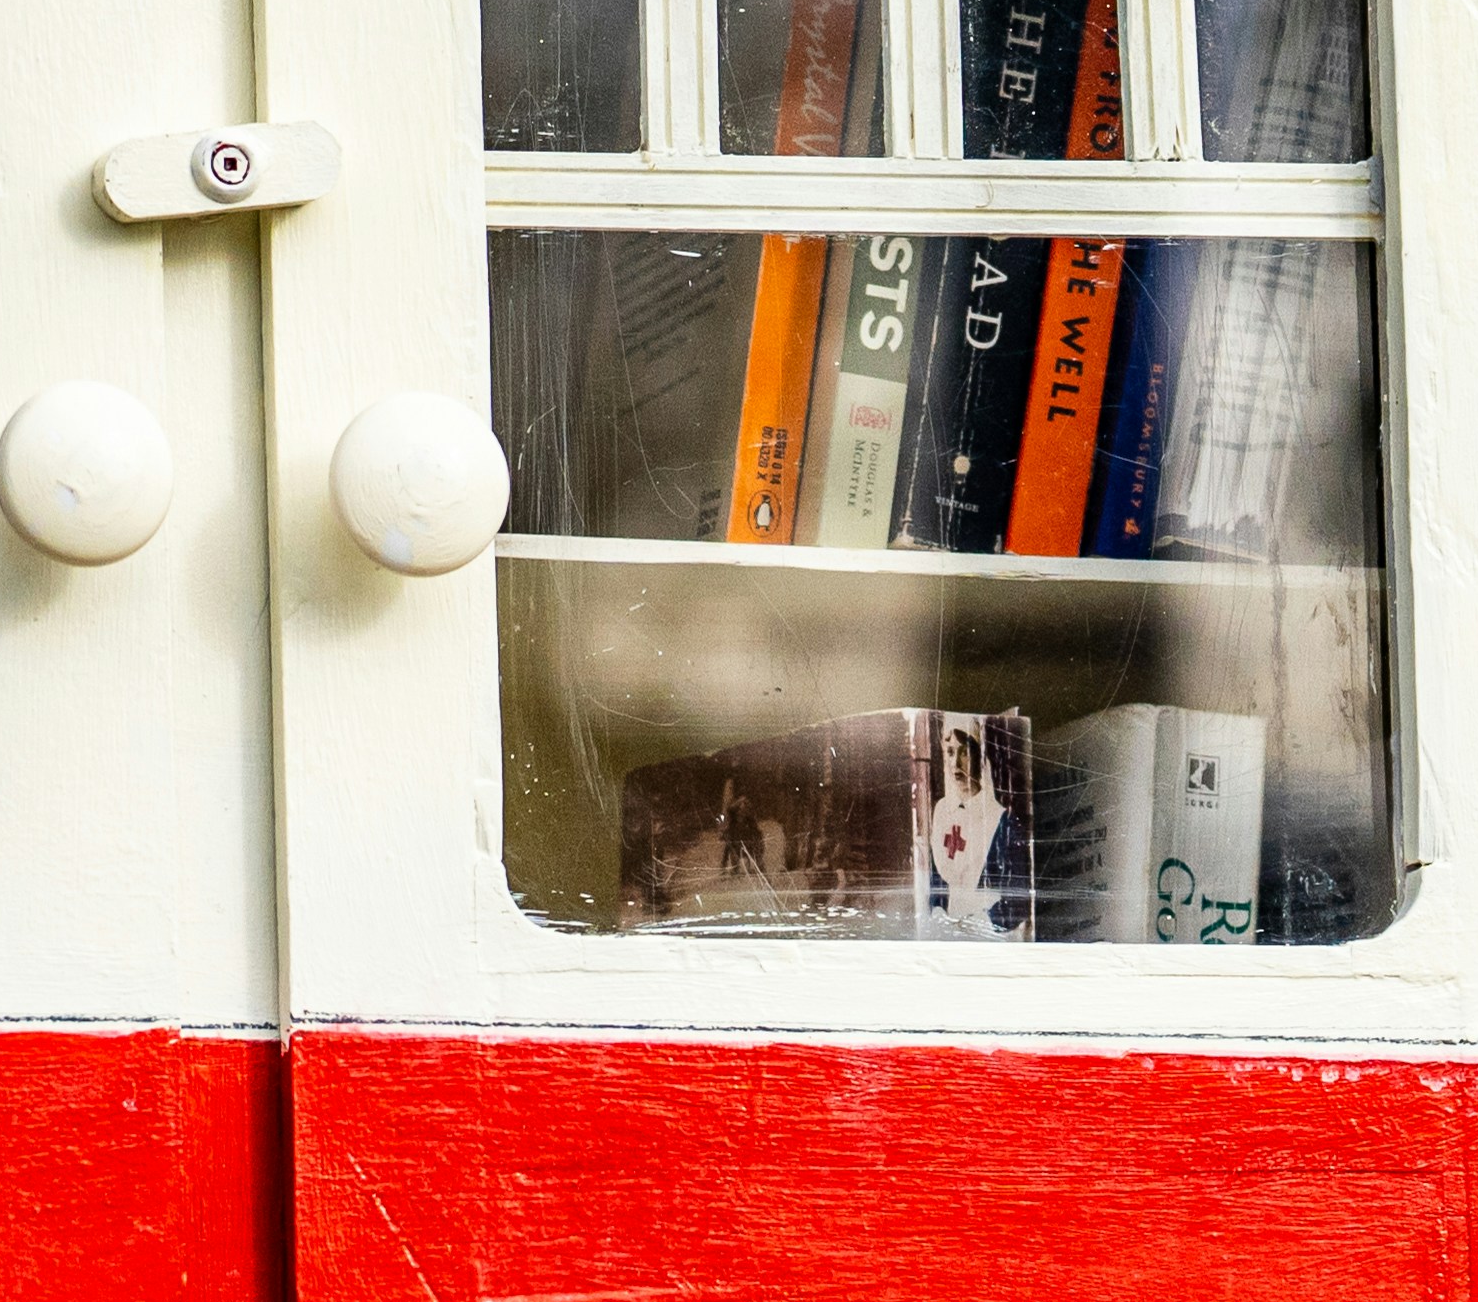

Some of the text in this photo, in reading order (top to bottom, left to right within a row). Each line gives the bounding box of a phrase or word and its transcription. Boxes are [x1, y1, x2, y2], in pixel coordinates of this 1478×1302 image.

[963, 251, 1008, 350] AD
[1067, 240, 1102, 297] HE
[1046, 315, 1091, 422] WELL
[1130, 362, 1164, 508] BLOOMSBURY
[861, 441, 881, 517] DOUGLAS &
[934, 495, 980, 513] VINTAGE
